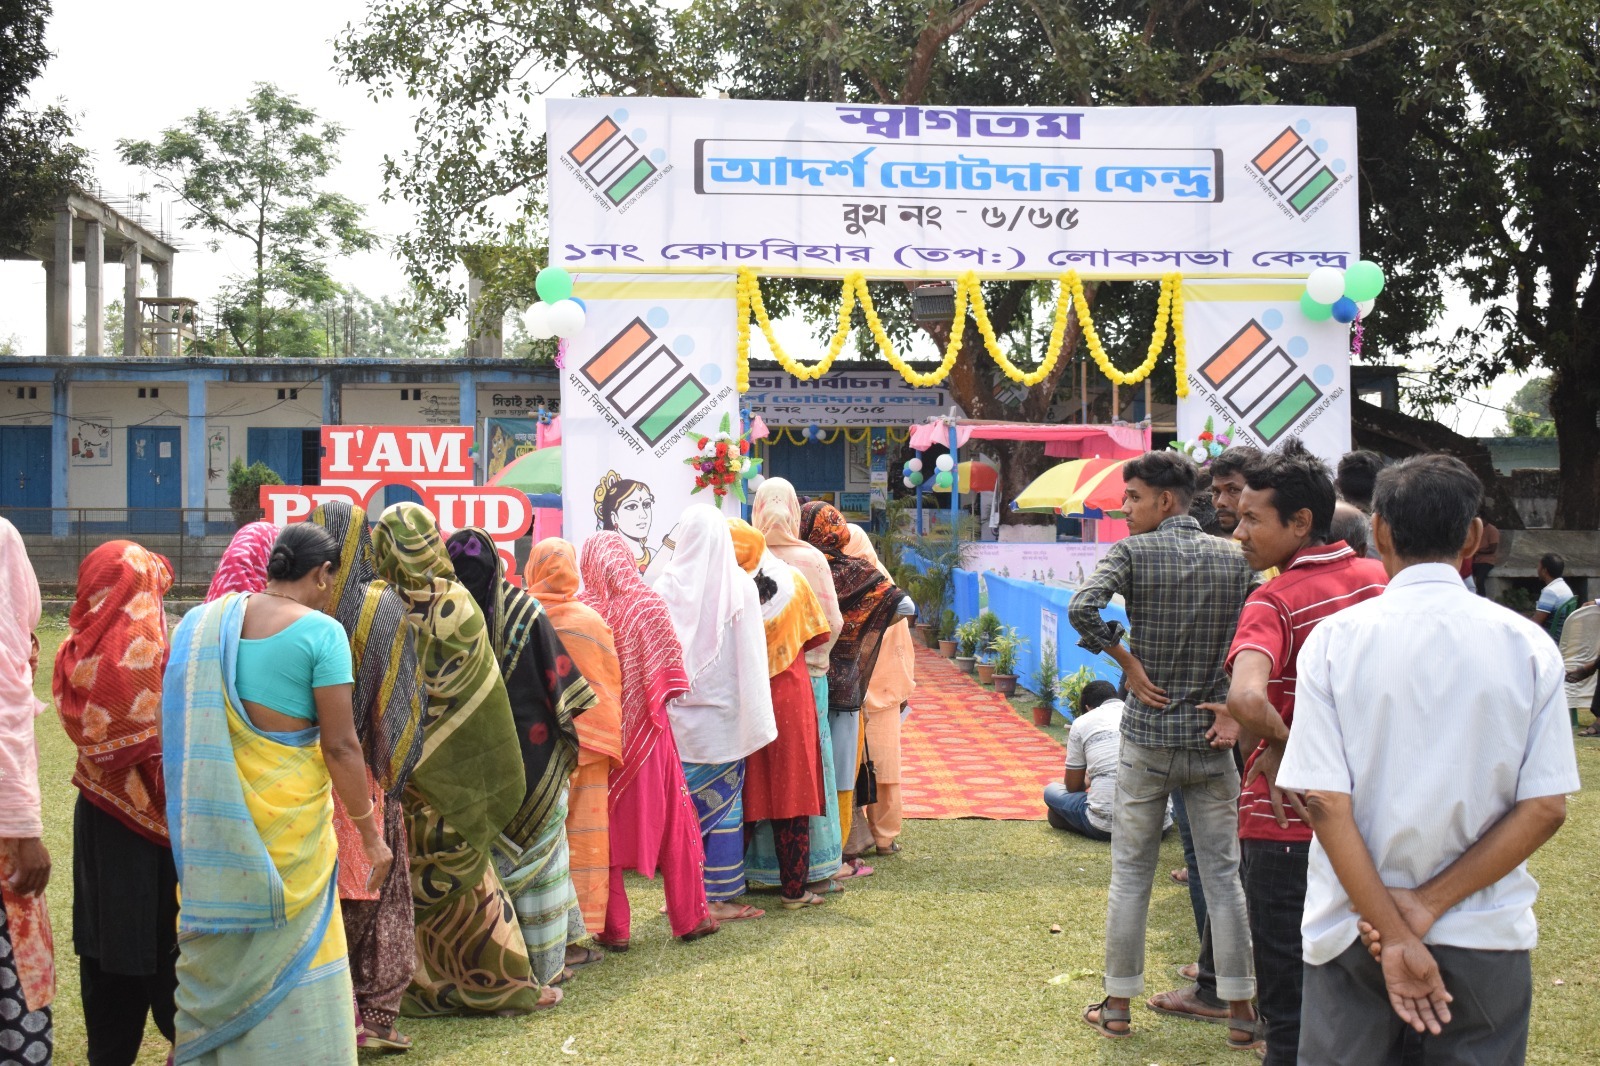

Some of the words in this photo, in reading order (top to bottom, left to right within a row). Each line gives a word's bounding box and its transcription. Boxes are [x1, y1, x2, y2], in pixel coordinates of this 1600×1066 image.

[836, 106, 1084, 140] স্বাগতম
[559, 155, 574, 172] भारत
[573, 168, 594, 194] निर्वाचन
[593, 192, 611, 212] आयोग
[618, 197, 637, 215] ELECTION
[635, 178, 658, 199] COMMISSION
[655, 172, 664, 180] OF
[661, 164, 674, 176] INDIA
[707, 146, 877, 188] আদর্শ
[880, 154, 1083, 190] ভোটদান
[1095, 166, 1212, 198] কেন্দ্র
[1243, 163, 1258, 181] भारत
[1256, 177, 1278, 202] निर्वाचन
[1276, 200, 1295, 220] आयोग
[842, 203, 887, 238] বুথ
[898, 204, 942, 230] নং
[981, 205, 1079, 231] ৬/৬৫
[1301, 205, 1319, 223] ELECTION
[1317, 186, 1340, 208] COMMISSION
[1337, 181, 1345, 190] OF
[1342, 174, 1354, 185] INDIA
[564, 243, 645, 262] ১নং
[660, 238, 875, 264] কোচবিহার
[1048, 248, 1234, 268] লোকসভা
[1252, 250, 1351, 270] কেন্দ্র
[569, 373, 591, 397] भारत
[587, 392, 619, 428] निर्वाचन
[617, 426, 645, 455] आयोग
[654, 432, 682, 459] ELECTION
[679, 404, 712, 436] COMMISSION
[707, 396, 719, 409] OF
[716, 385, 733, 403] INDIA
[1187, 373, 1208, 396] भारत
[1204, 393, 1236, 427] निर्वाचन
[1293, 404, 1327, 436] COMMISSION
[1322, 397, 1331, 409] OF
[1329, 386, 1345, 403] INDIA
